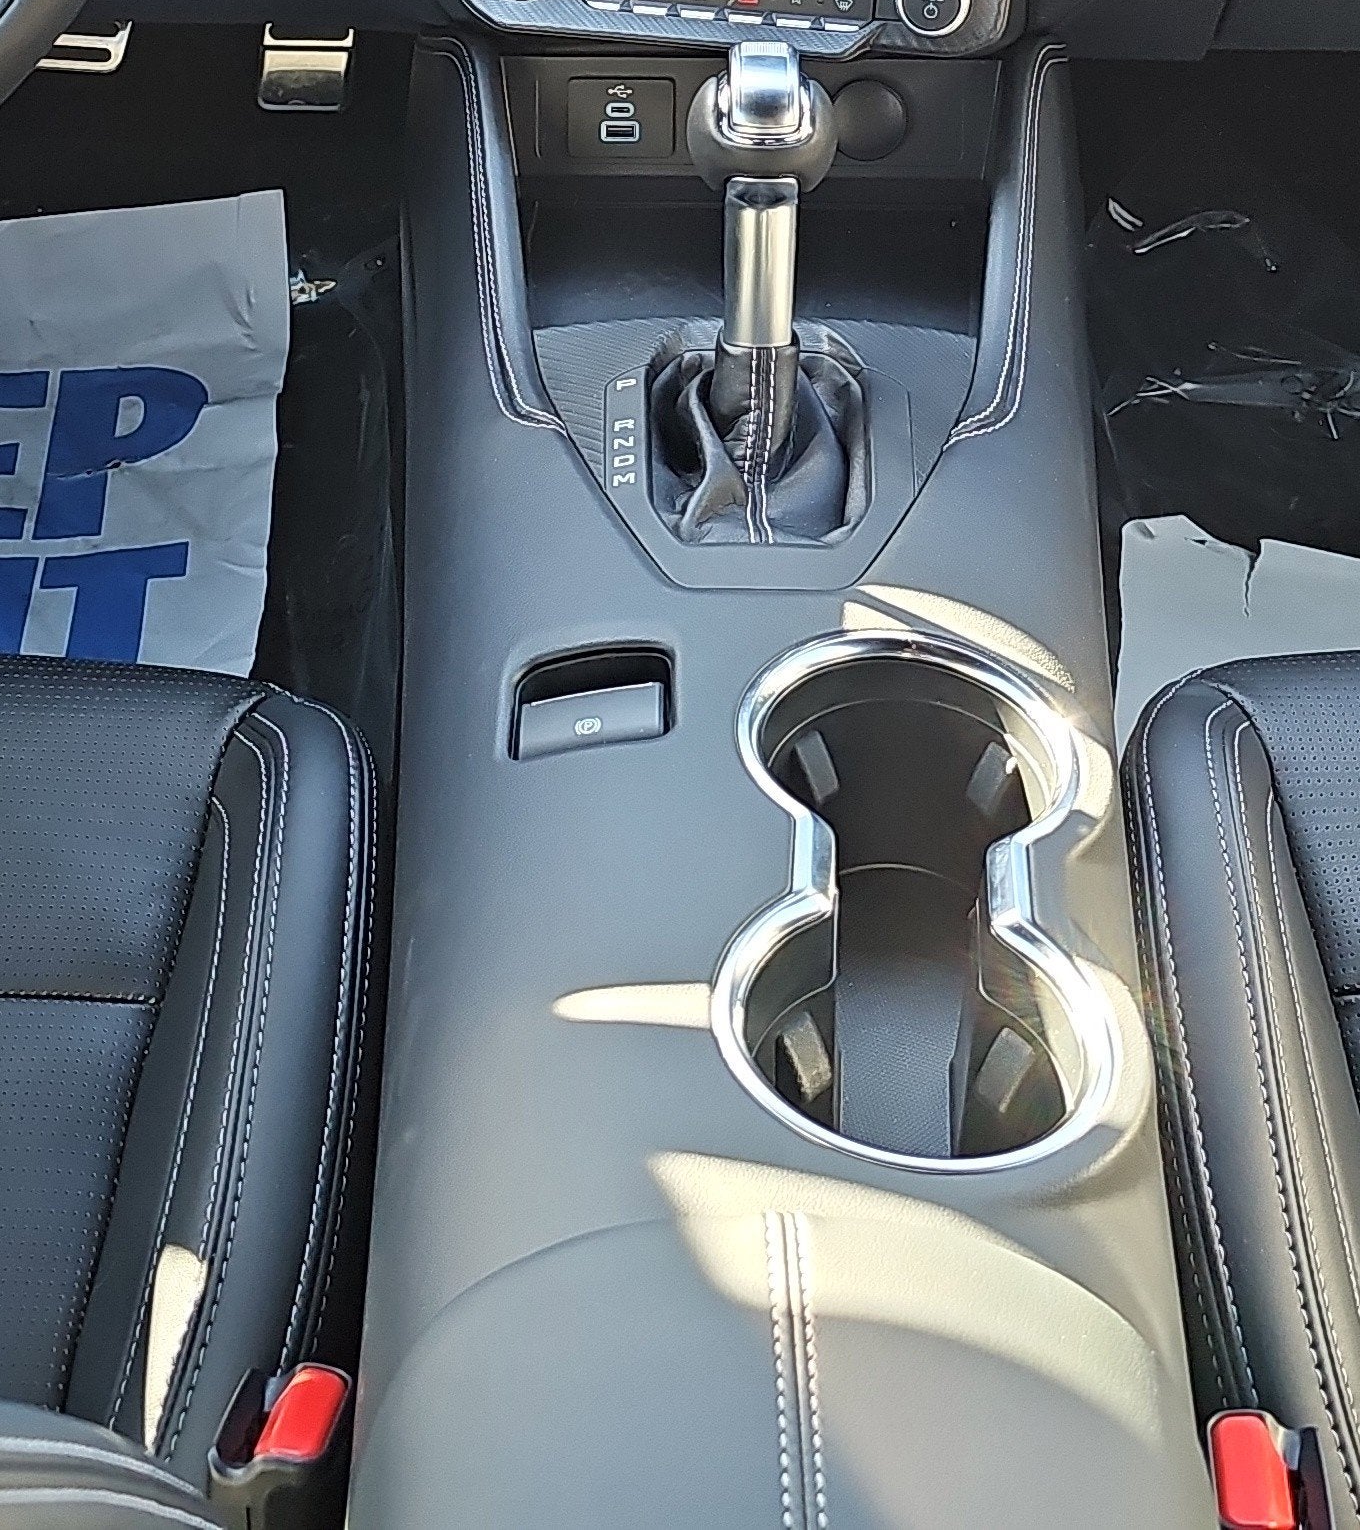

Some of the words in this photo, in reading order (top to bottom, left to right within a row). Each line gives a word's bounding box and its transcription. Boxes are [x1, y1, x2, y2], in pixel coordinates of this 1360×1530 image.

[616, 378, 637, 391] P
[613, 418, 635, 432] R
[613, 454, 635, 468] D
